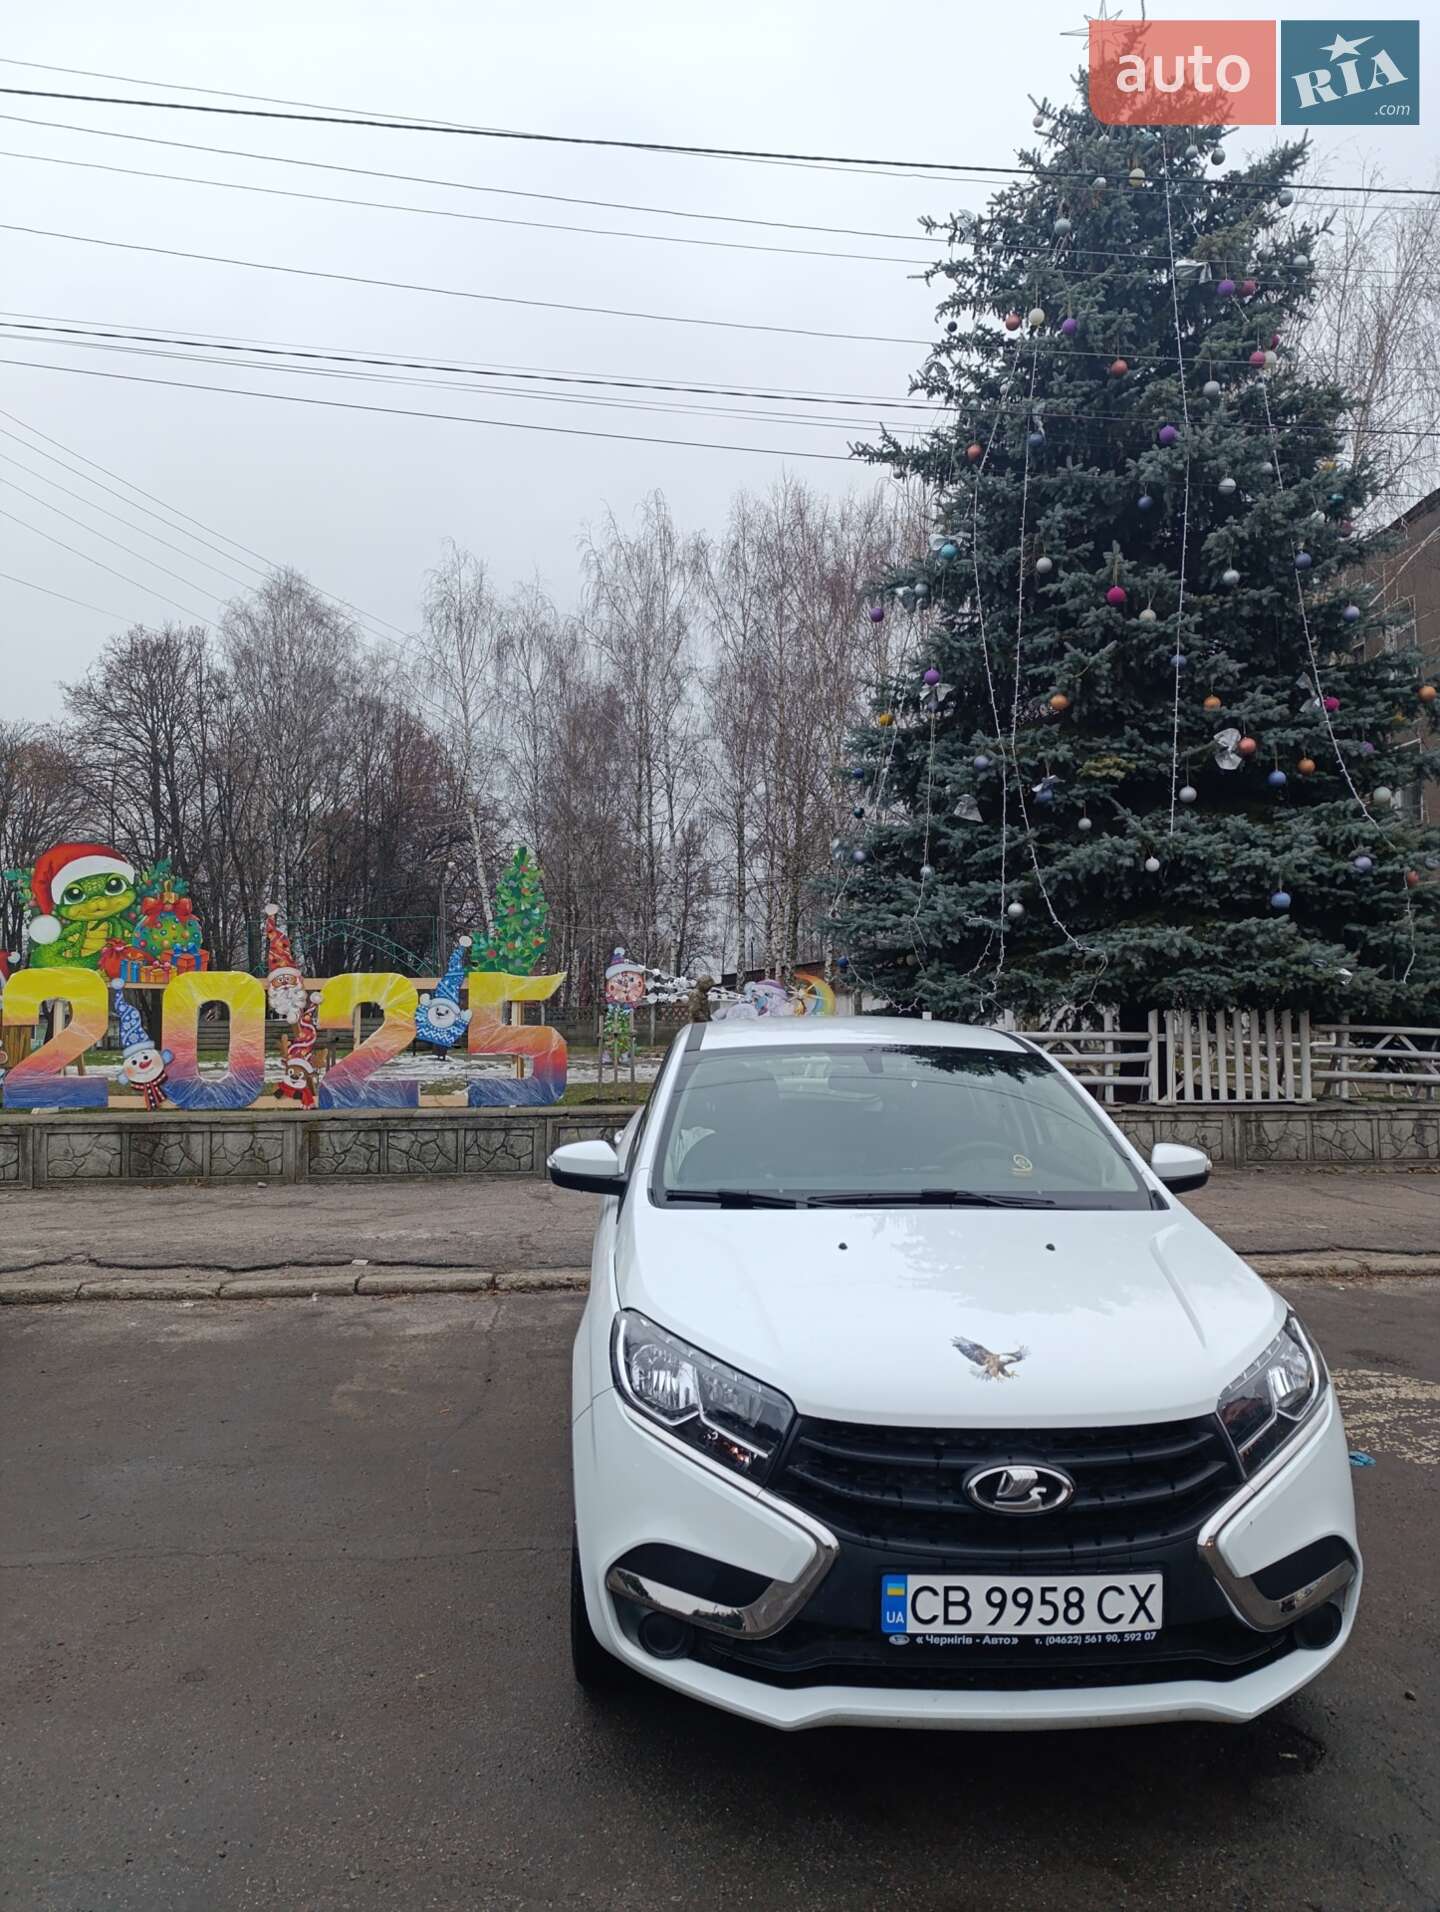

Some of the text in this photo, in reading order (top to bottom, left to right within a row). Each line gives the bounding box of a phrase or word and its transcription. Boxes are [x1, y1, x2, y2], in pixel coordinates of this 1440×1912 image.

[2, 968, 568, 1108] 2025
[886, 1611, 905, 1624] UA
[910, 1583, 1157, 1626] CB 9958 CX
[1045, 1634, 1082, 1646] (04622)
[1084, 1634, 1102, 1644] 561
[1105, 1633, 1121, 1643] 90,
[1123, 1632, 1142, 1642] 592
[1144, 1631, 1157, 1641] 07
